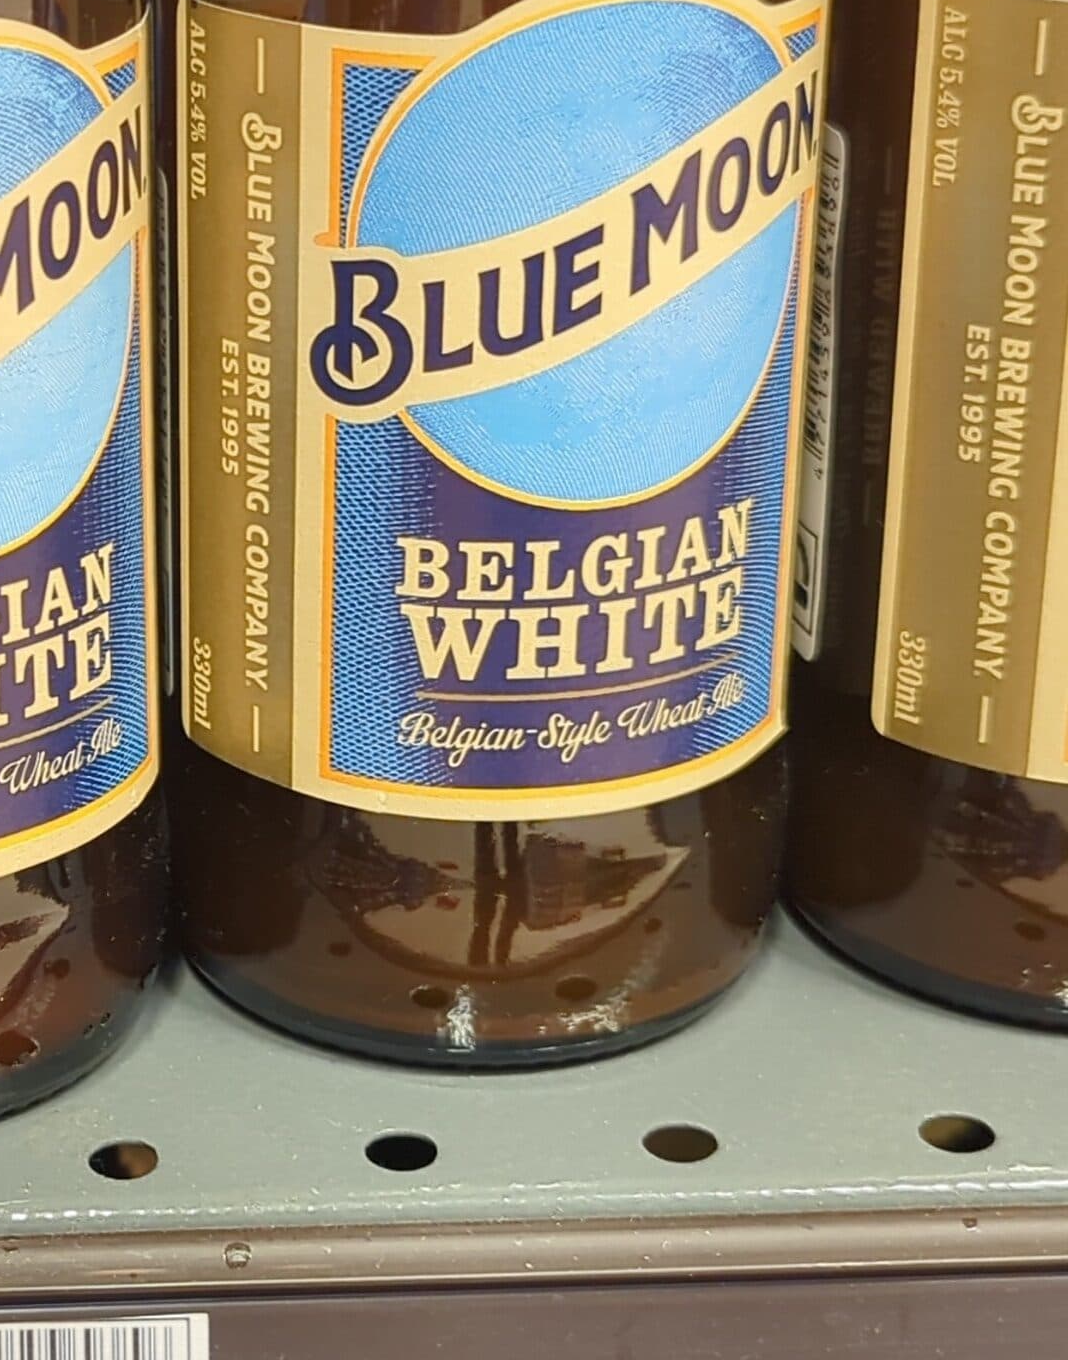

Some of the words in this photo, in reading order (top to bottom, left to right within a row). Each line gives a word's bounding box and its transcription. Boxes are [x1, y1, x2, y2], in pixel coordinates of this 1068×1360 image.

[190, 18, 207, 81] ALC
[941, 5, 967, 63] ALC
[190, 83, 207, 143] 5.4%
[935, 67, 963, 129] 5.4%
[190, 150, 207, 200] VOL
[241, 112, 282, 222] BLUE
[932, 137, 959, 187] VOL
[1011, 94, 1064, 204] BLUE
[247, 231, 275, 342] MOON
[310, 224, 604, 407] BLUE
[1002, 214, 1047, 327] MOON
[220, 338, 239, 398] EST.
[964, 323, 990, 384] EST.
[220, 407, 239, 476] 1995
[245, 353, 271, 514] BREWING
[958, 393, 987, 464] 1995
[988, 337, 1031, 501] BREWING
[395, 499, 754, 601] BELGIAN
[400, 566, 743, 681] WHITE
[193, 636, 213, 730] 330ml
[396, 710, 612, 768] Belgian-Style
[618, 692, 703, 738] Wheat
[701, 670, 747, 717] Ale
[893, 630, 926, 725] 330ml
[85, 717, 123, 763] Ale
